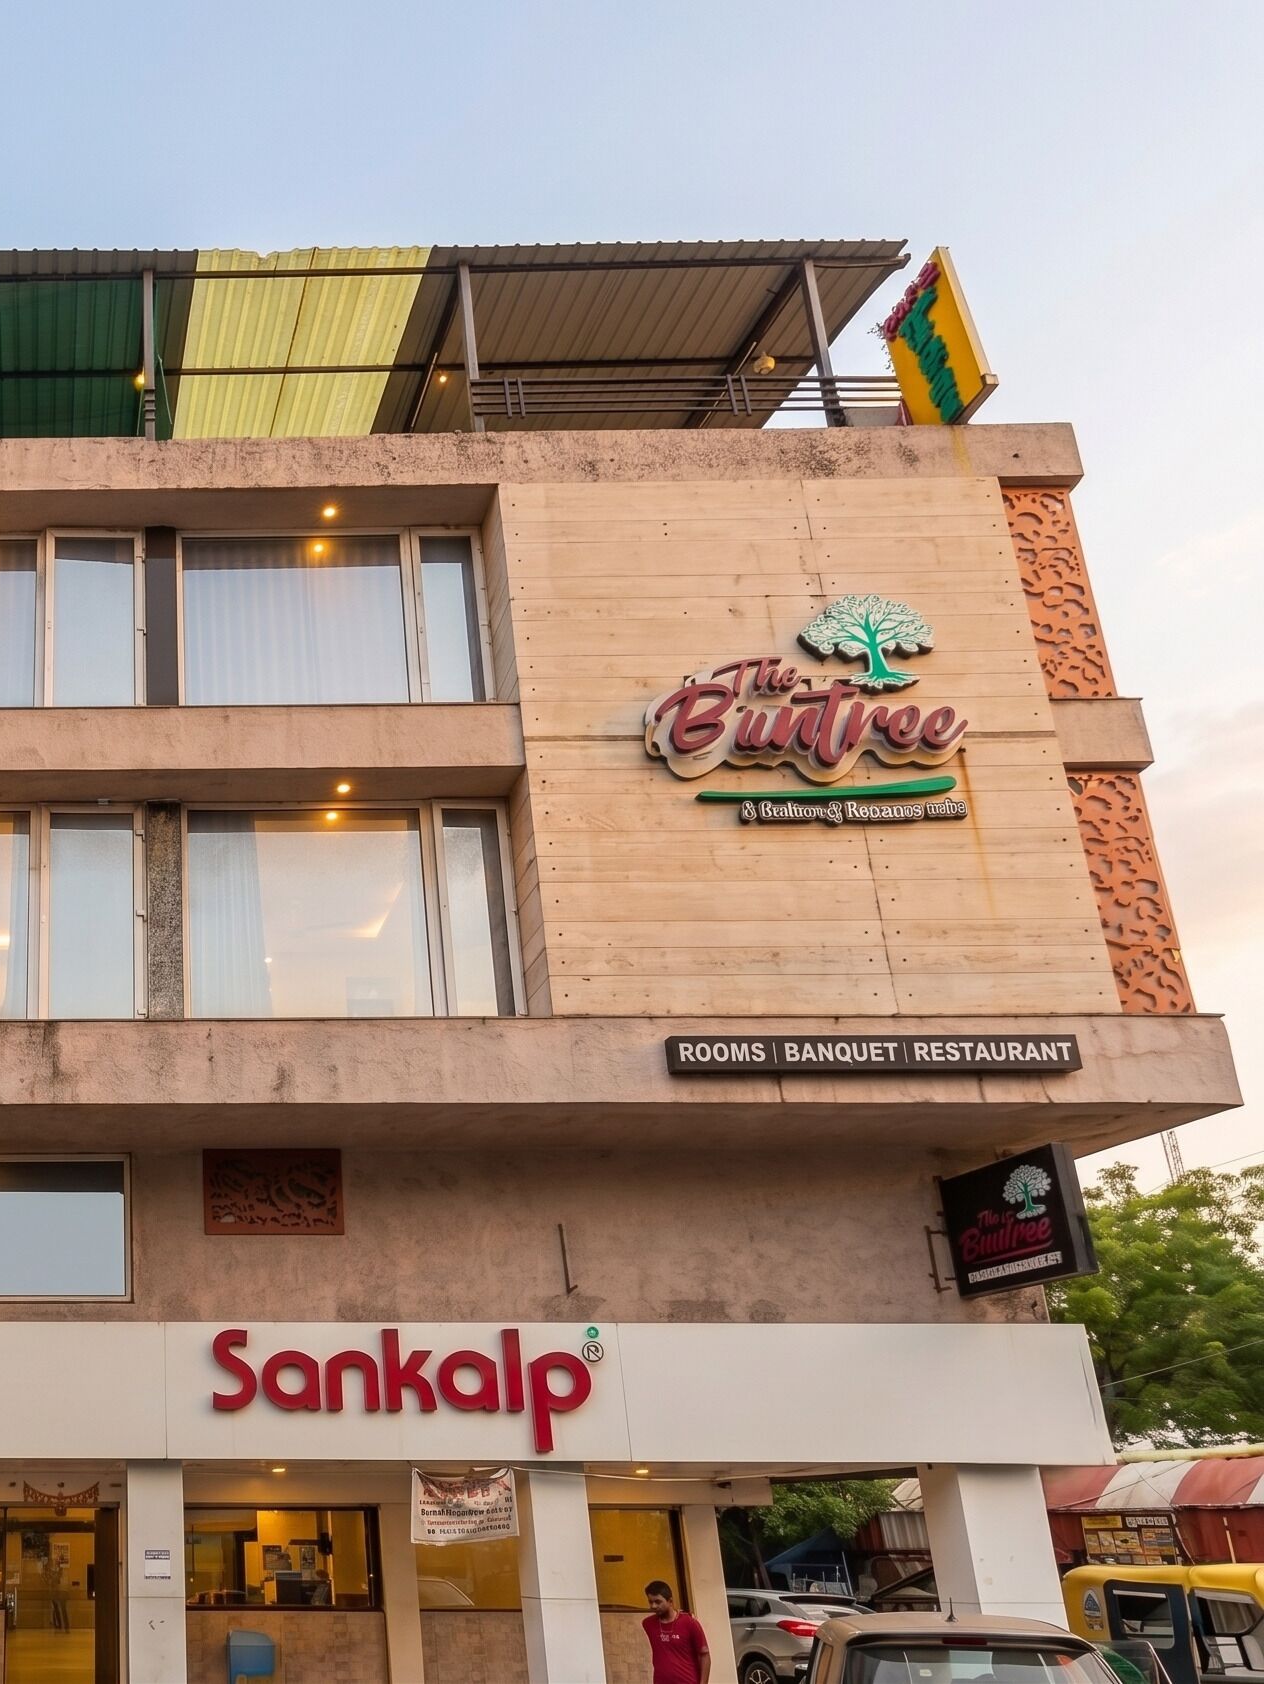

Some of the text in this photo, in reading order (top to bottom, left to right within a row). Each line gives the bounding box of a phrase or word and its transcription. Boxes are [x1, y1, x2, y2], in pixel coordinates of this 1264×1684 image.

[711, 656, 801, 698] The
[678, 1041, 1072, 1066] ROOMS BANQUET RESTAURANT
[212, 1328, 592, 1453] Sankalp
